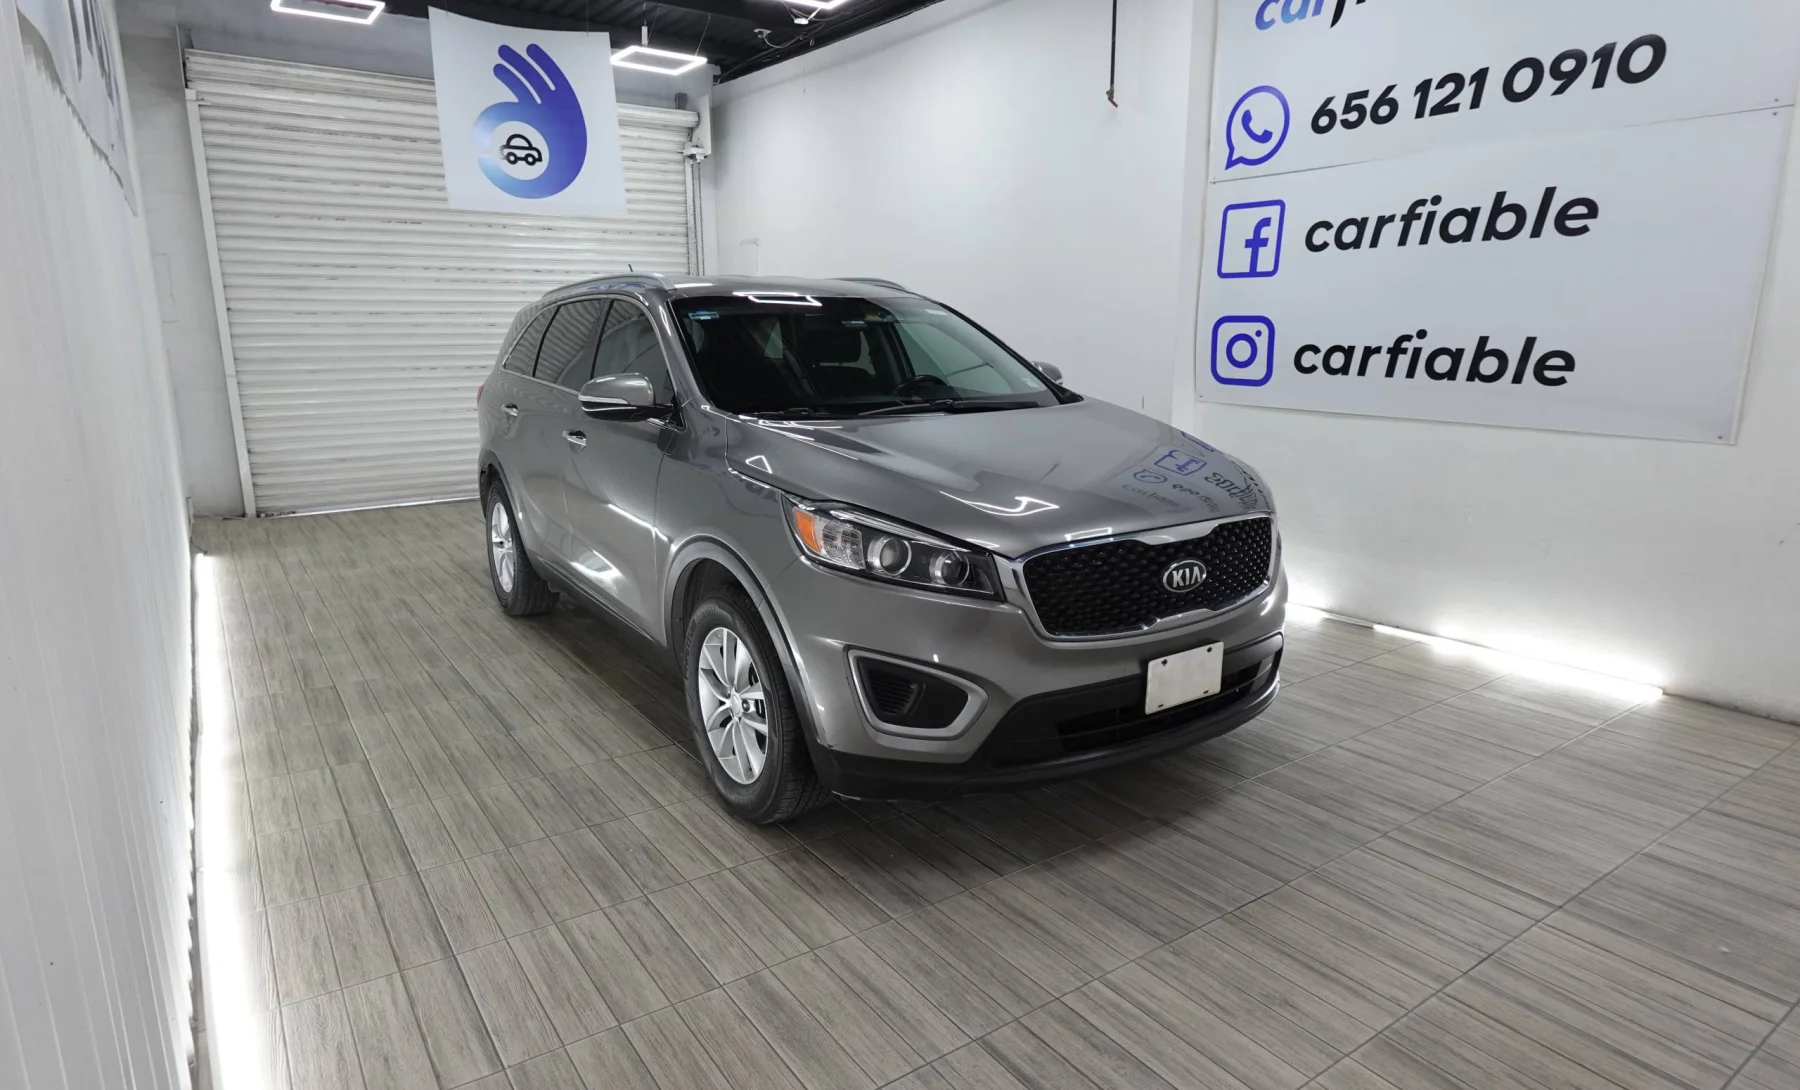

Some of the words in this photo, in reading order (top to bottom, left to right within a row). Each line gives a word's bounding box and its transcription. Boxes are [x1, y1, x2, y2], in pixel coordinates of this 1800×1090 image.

[1310, 84, 1399, 135] 656
[1413, 66, 1490, 120] 121
[1502, 34, 1667, 103] 0910
[1304, 186, 1599, 253] carfiable
[1293, 328, 1576, 387] carfiable
[1171, 566, 1201, 588] KIA
